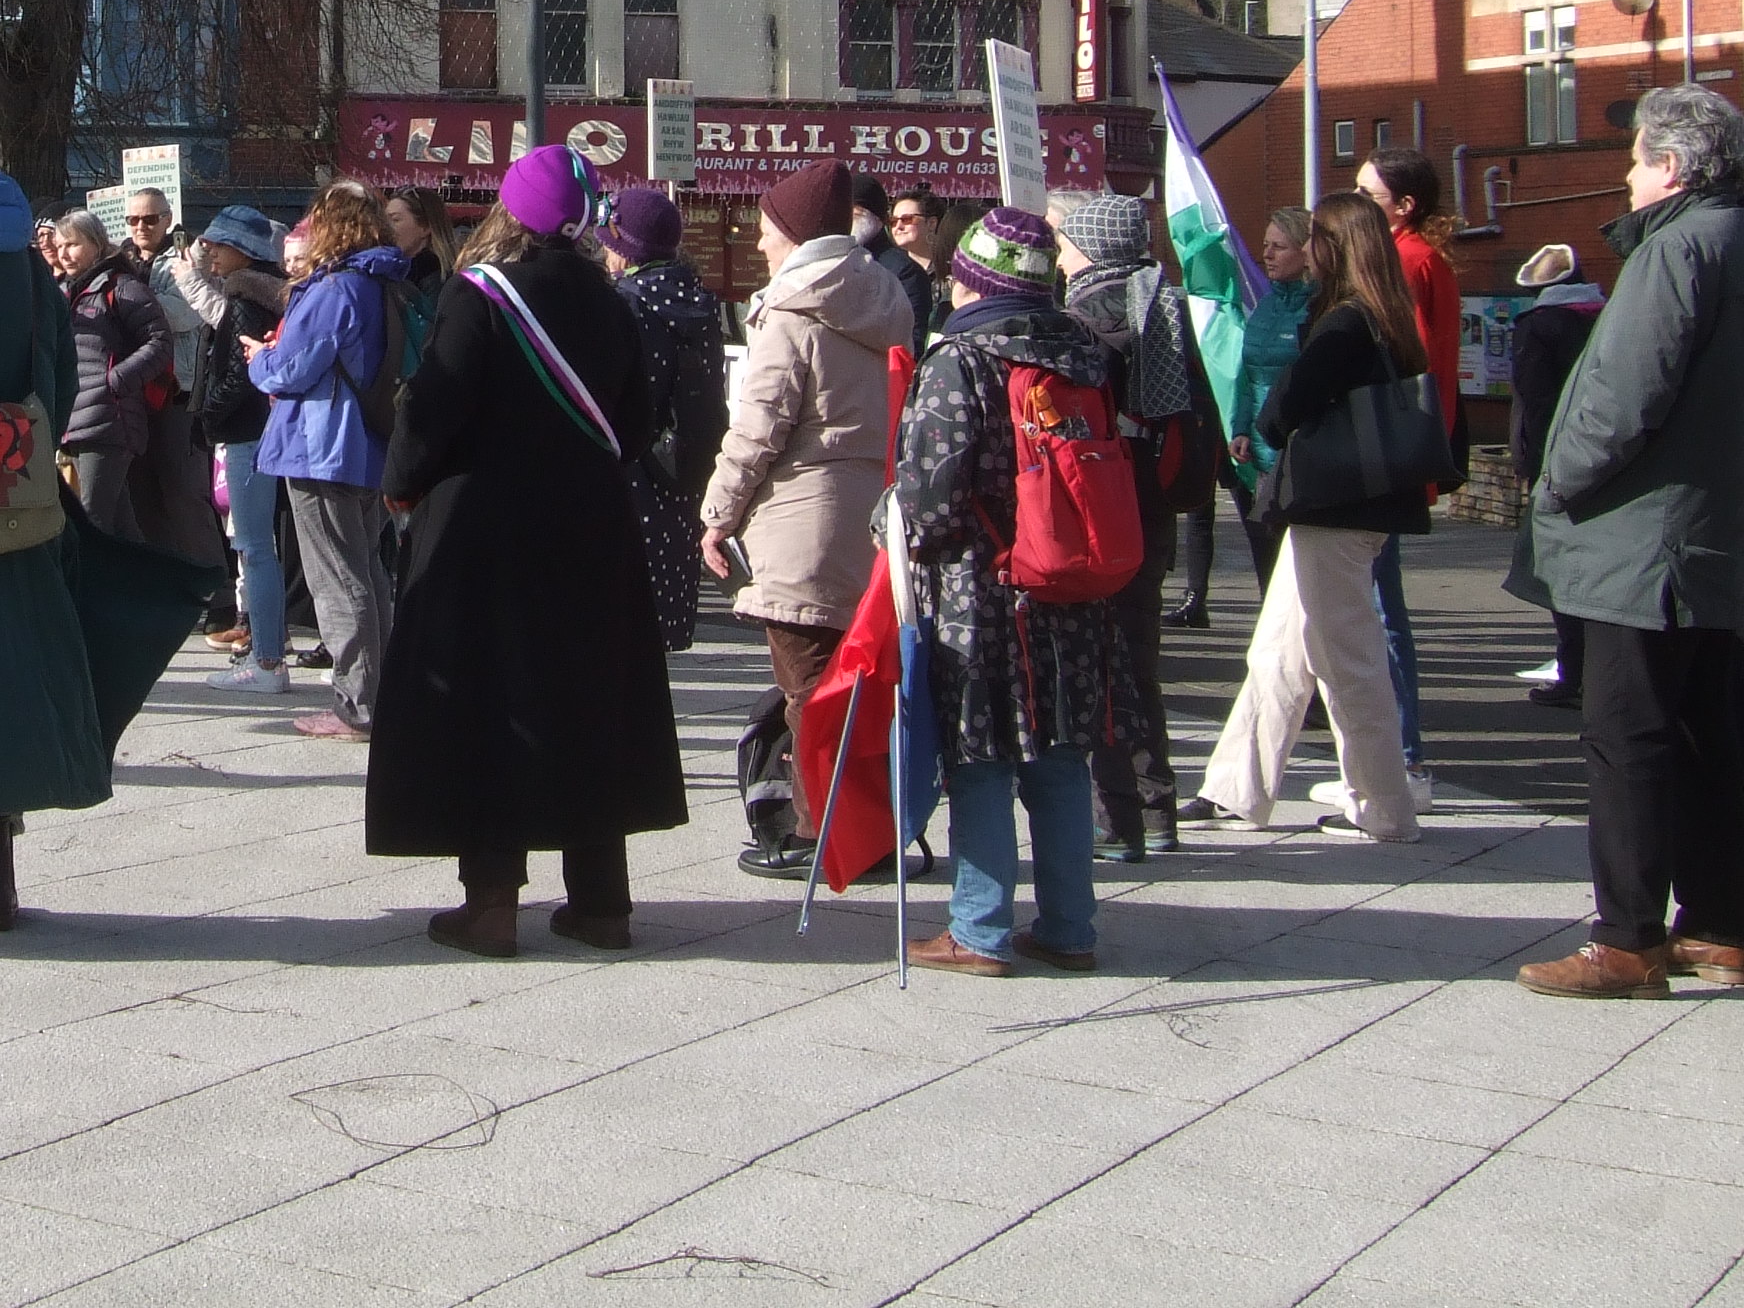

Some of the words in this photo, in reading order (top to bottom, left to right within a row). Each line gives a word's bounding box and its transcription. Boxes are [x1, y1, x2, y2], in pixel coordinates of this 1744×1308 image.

[696, 122, 835, 153] RILL
[849, 125, 1049, 157] HOUS
[127, 162, 176, 174] DEFENDING
[694, 157, 755, 170] AURANT
[758, 159, 768, 171] &
[858, 160, 868, 172] &
[872, 160, 915, 173] JUICE
[918, 161, 949, 174] BAR
[957, 162, 996, 175] 01633
[130, 174, 173, 185] WOMEN'S
